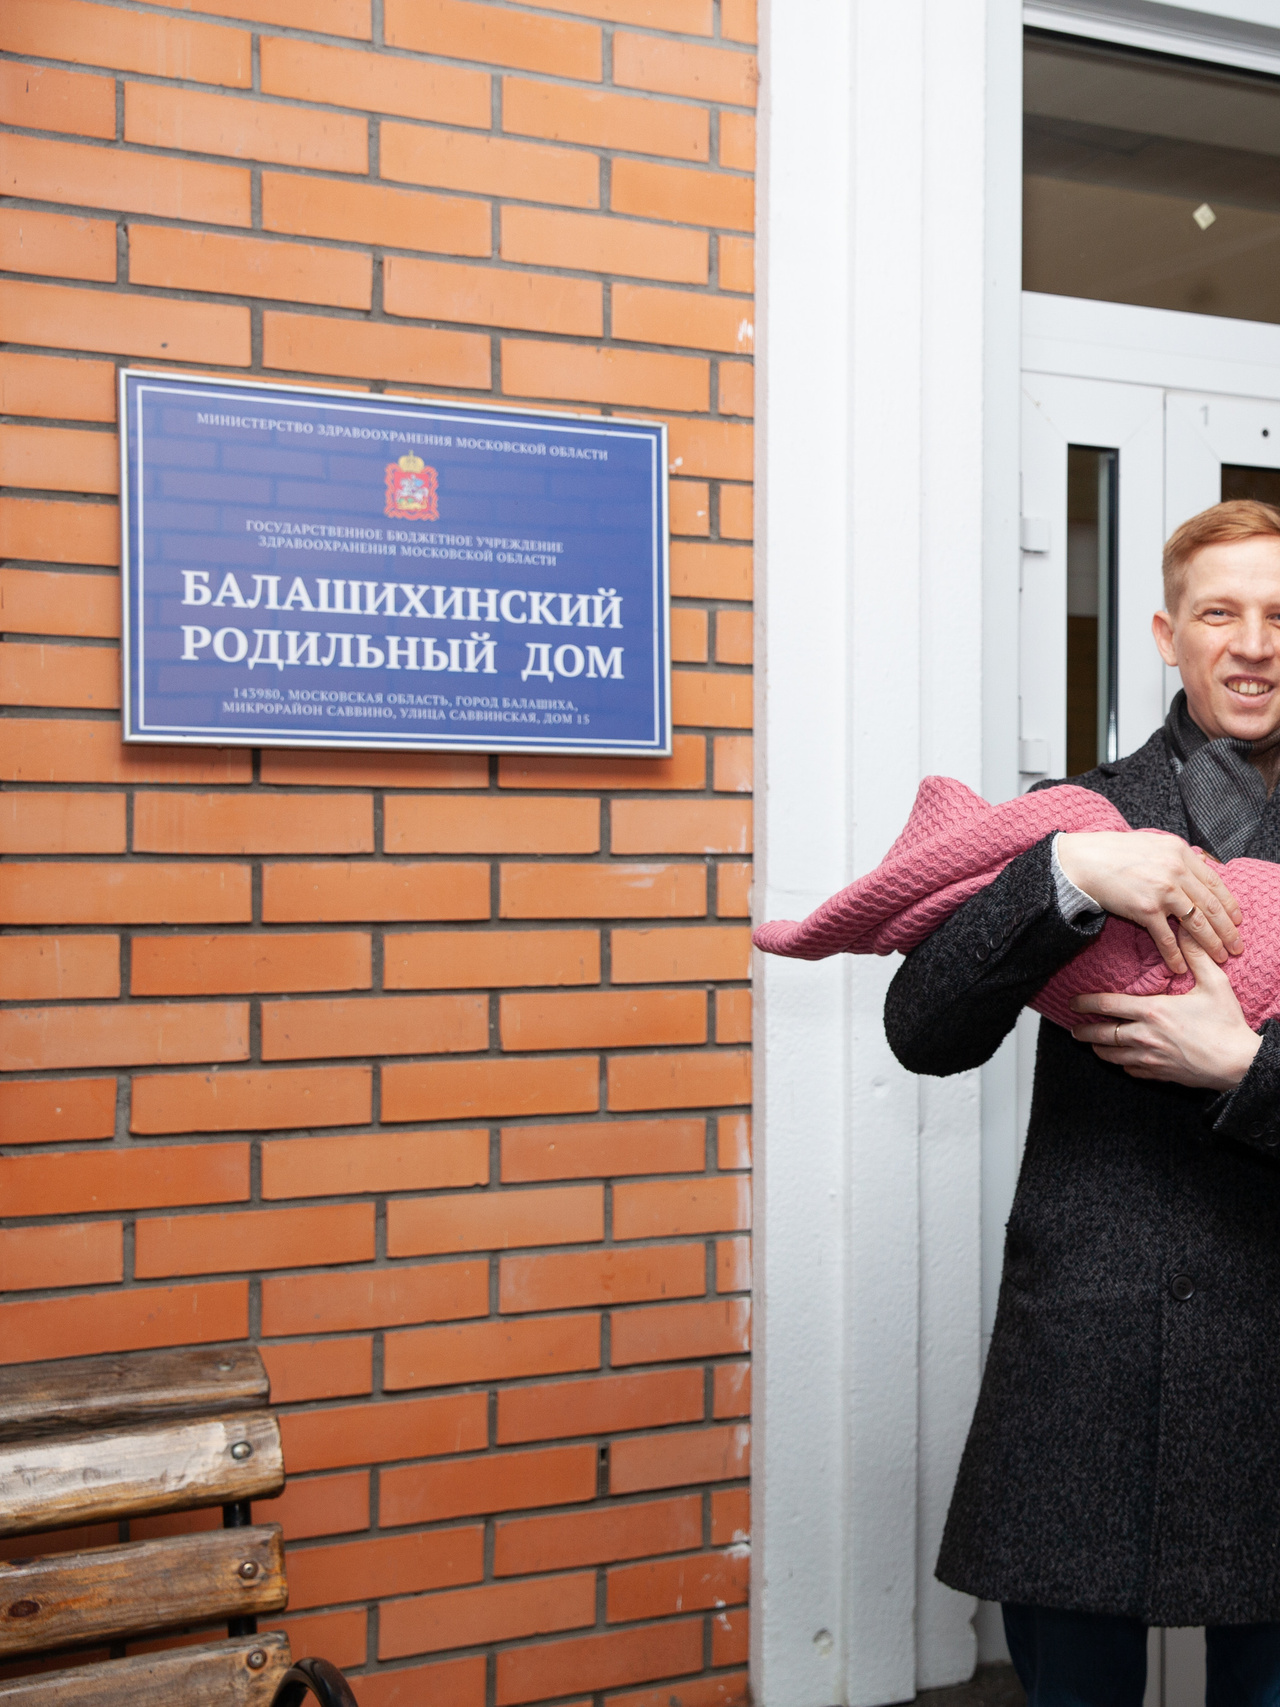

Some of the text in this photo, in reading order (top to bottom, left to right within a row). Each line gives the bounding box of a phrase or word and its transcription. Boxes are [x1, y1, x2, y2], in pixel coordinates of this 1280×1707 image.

[197, 412, 608, 461] МИНИСТЕРСТВО ЗДРАВООХРАНЕНИЯ МОСКОВСКОЙ ОБЛАСТИ
[246, 519, 564, 553] ГОСУДАРСТВЕННОЕ БЮДЖЕТНОЕ УЧРЕЖДЕНИЕ
[258, 535, 557, 566] ЗДРАВООХРАНЕНИЯ МОСКОВСКОЙ ОБЛАСТИ
[180, 570, 624, 629] БАЛАШИХИНСКИЙ
[180, 625, 625, 682] РОДИЛЬНЫЙ ДОМ
[223, 701, 590, 725] МИКРОРАЙОН САВВИНО, УЛИЦА САВВИНСКАЯ, ДОМ 15
[233, 687, 579, 712] 143980, МОСКОВСКАЯ ОБЛАСТЬ, ГОРОД БАЛАШИХА,
